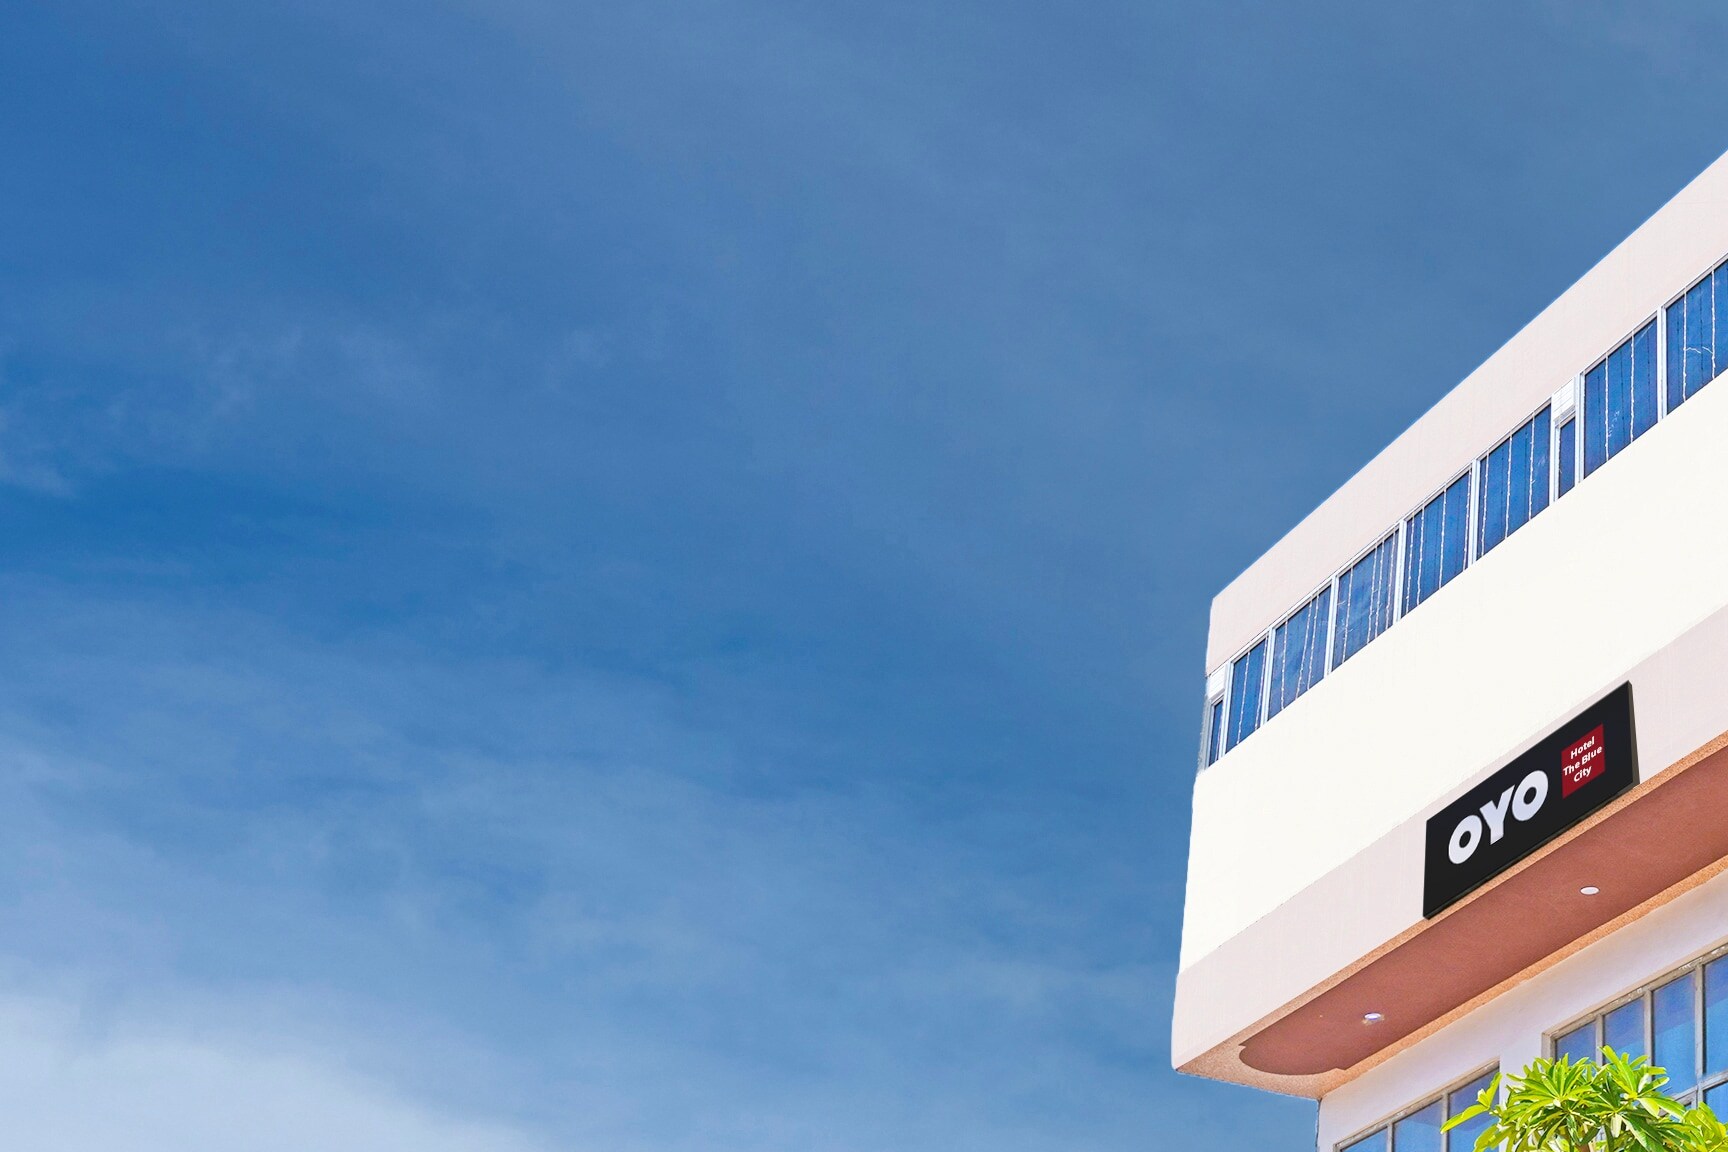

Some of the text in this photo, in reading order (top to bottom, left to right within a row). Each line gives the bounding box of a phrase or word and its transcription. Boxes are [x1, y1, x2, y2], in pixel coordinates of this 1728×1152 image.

[1562, 746, 1602, 776] The Blue
[1570, 735, 1595, 760] Hotel
[1573, 766, 1592, 782] City
[1448, 770, 1549, 864] OYO
